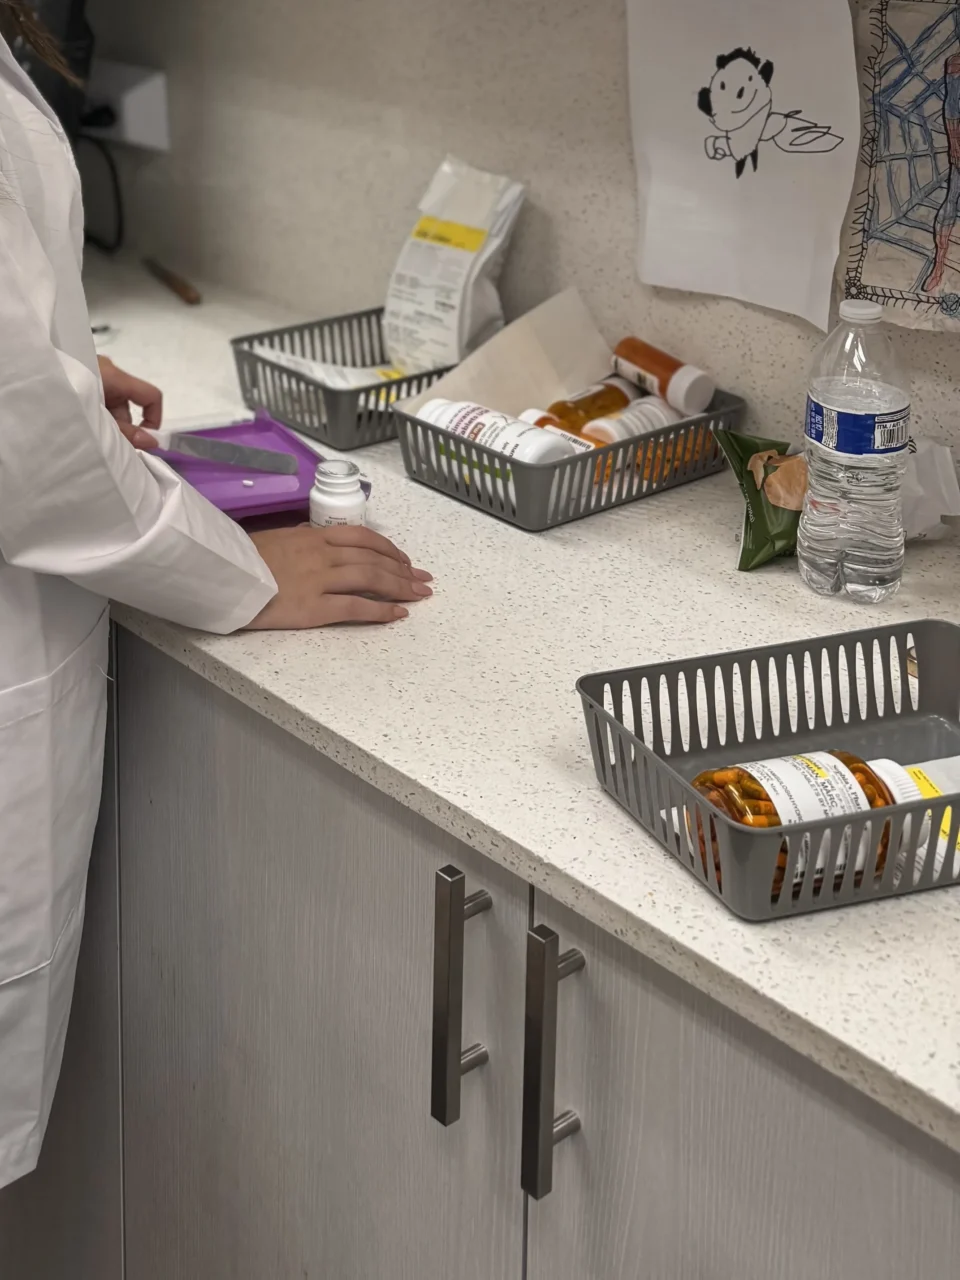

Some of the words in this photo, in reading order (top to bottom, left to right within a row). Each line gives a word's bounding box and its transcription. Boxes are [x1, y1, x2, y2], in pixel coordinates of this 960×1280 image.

[474, 424, 484, 434] mg
[801, 771, 820, 796] TABLETS
[820, 781, 838, 808] MARC
